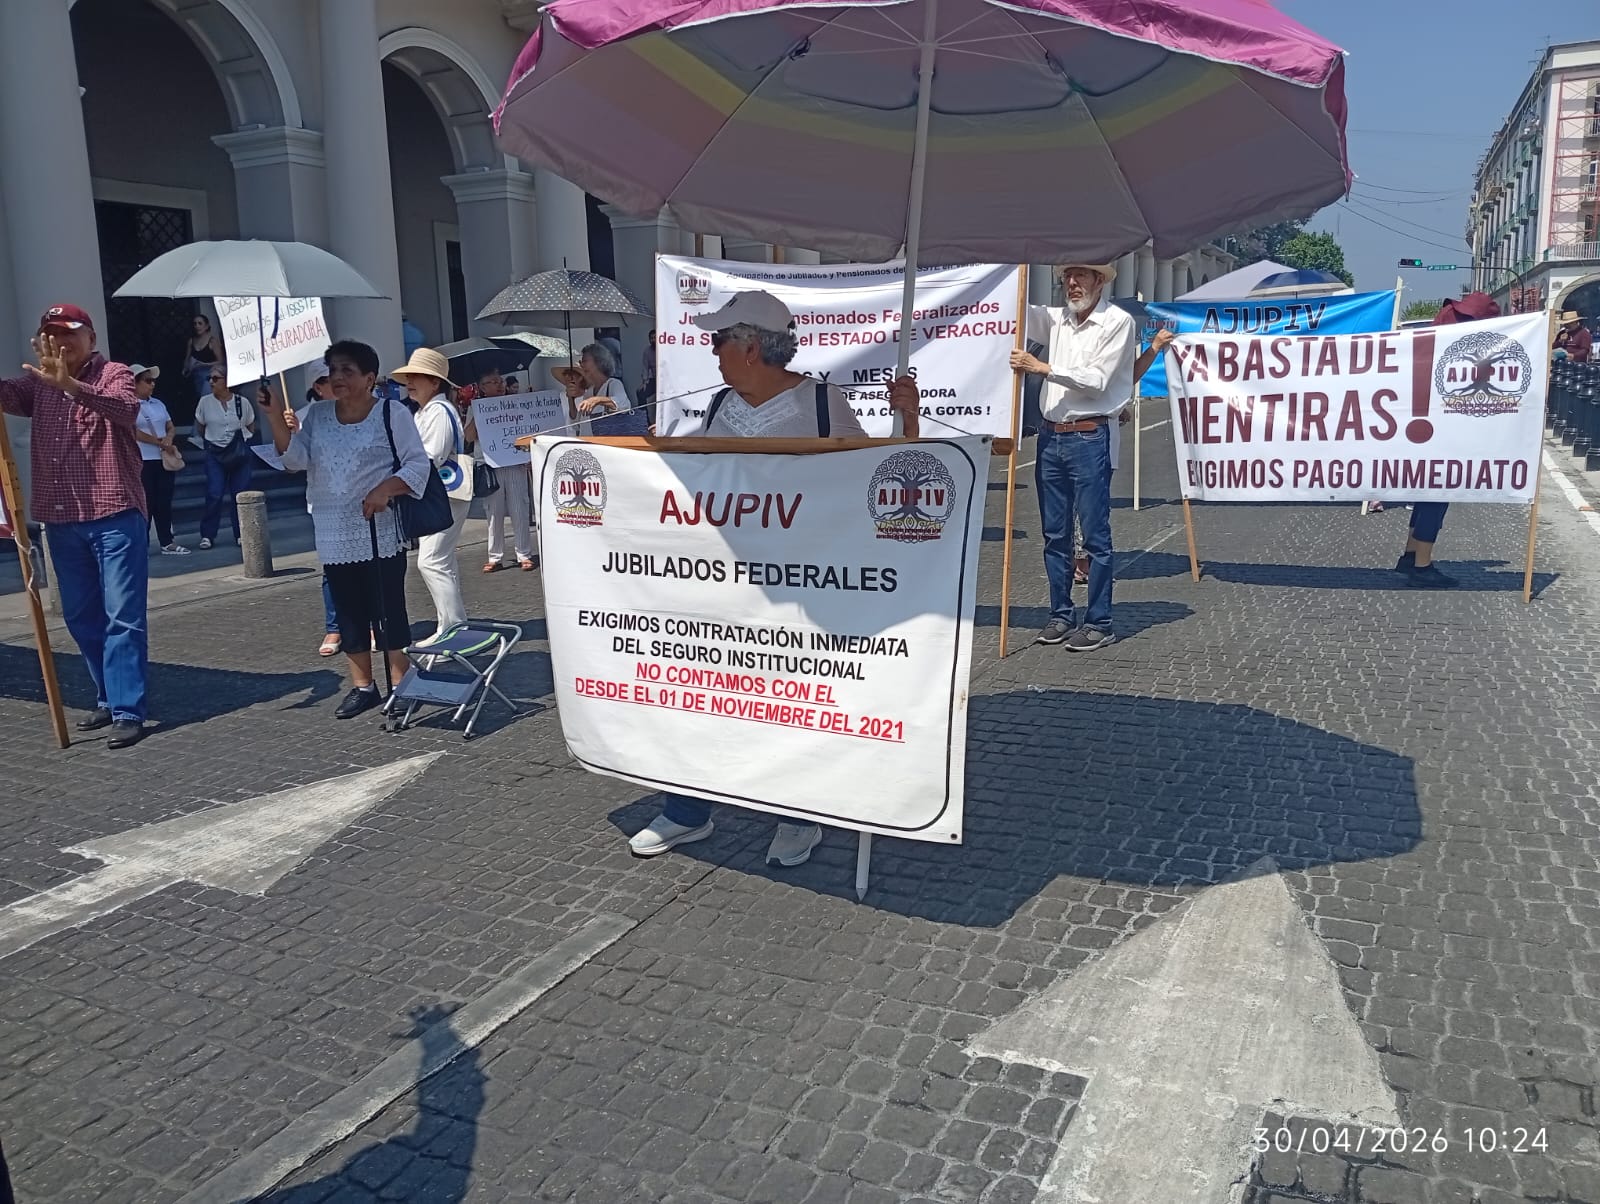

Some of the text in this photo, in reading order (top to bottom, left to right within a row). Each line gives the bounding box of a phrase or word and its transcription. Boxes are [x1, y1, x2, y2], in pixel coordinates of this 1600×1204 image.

[829, 273, 834, 281] y
[836, 268, 891, 279] Pensionados
[793, 301, 999, 325] nsionados Feeralizados
[1201, 302, 1327, 335] AJUPIV
[658, 333, 676, 345] de
[682, 332, 695, 346] la
[800, 332, 812, 346] el
[819, 330, 886, 346] ESTADO
[1170, 333, 1400, 383] YA BASTA DE
[853, 366, 917, 383] MESS
[860, 388, 957, 401] ASEGDORA
[485, 413, 524, 425] restituye
[867, 407, 876, 417] A
[936, 405, 982, 416] GOTAS
[1293, 459, 1363, 489] PAGO
[1371, 459, 1528, 490] INMEDIATO
[560, 481, 600, 496] AJUPIV
[878, 489, 945, 506] AJUPIV
[660, 490, 803, 529] AJUPIV
[602, 551, 898, 593] JUBILADOS FEDERALES
[578, 610, 909, 657] EXIGIMOS CONTRATACIÓN INMEDIATA
[613, 636, 865, 680] DEL SEGURO INSTITUCIONAL
[636, 662, 836, 704] NO CONTAMOS CON EL
[575, 677, 903, 740] DESDE EL 01 DE NOVIEMBRE DEL 2021
